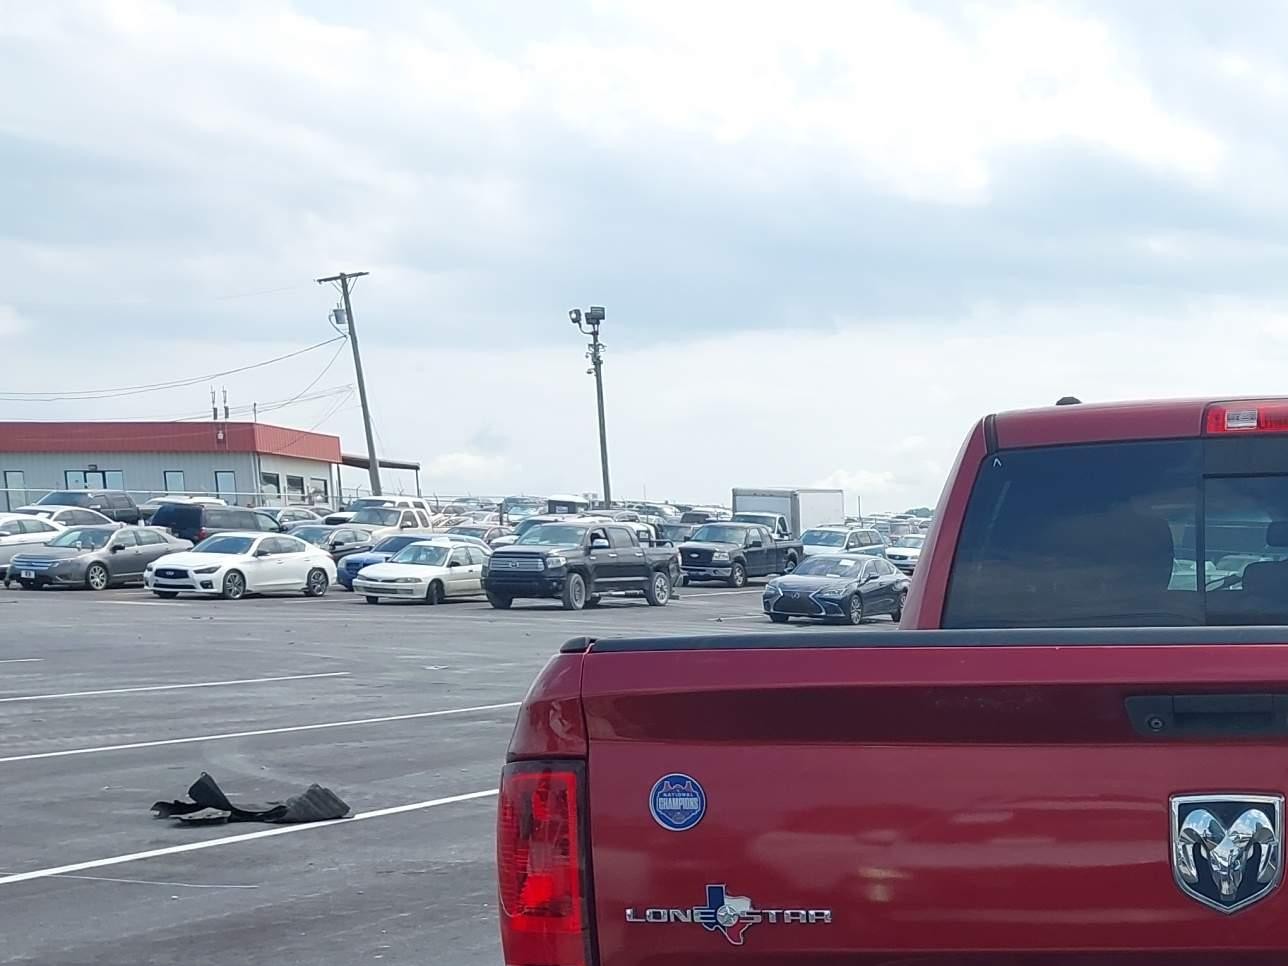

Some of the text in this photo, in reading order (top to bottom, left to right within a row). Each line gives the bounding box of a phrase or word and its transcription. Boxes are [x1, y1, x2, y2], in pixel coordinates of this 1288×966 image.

[658, 797, 699, 810] CHAMPIONS
[625, 906, 832, 923] LONE STAR
